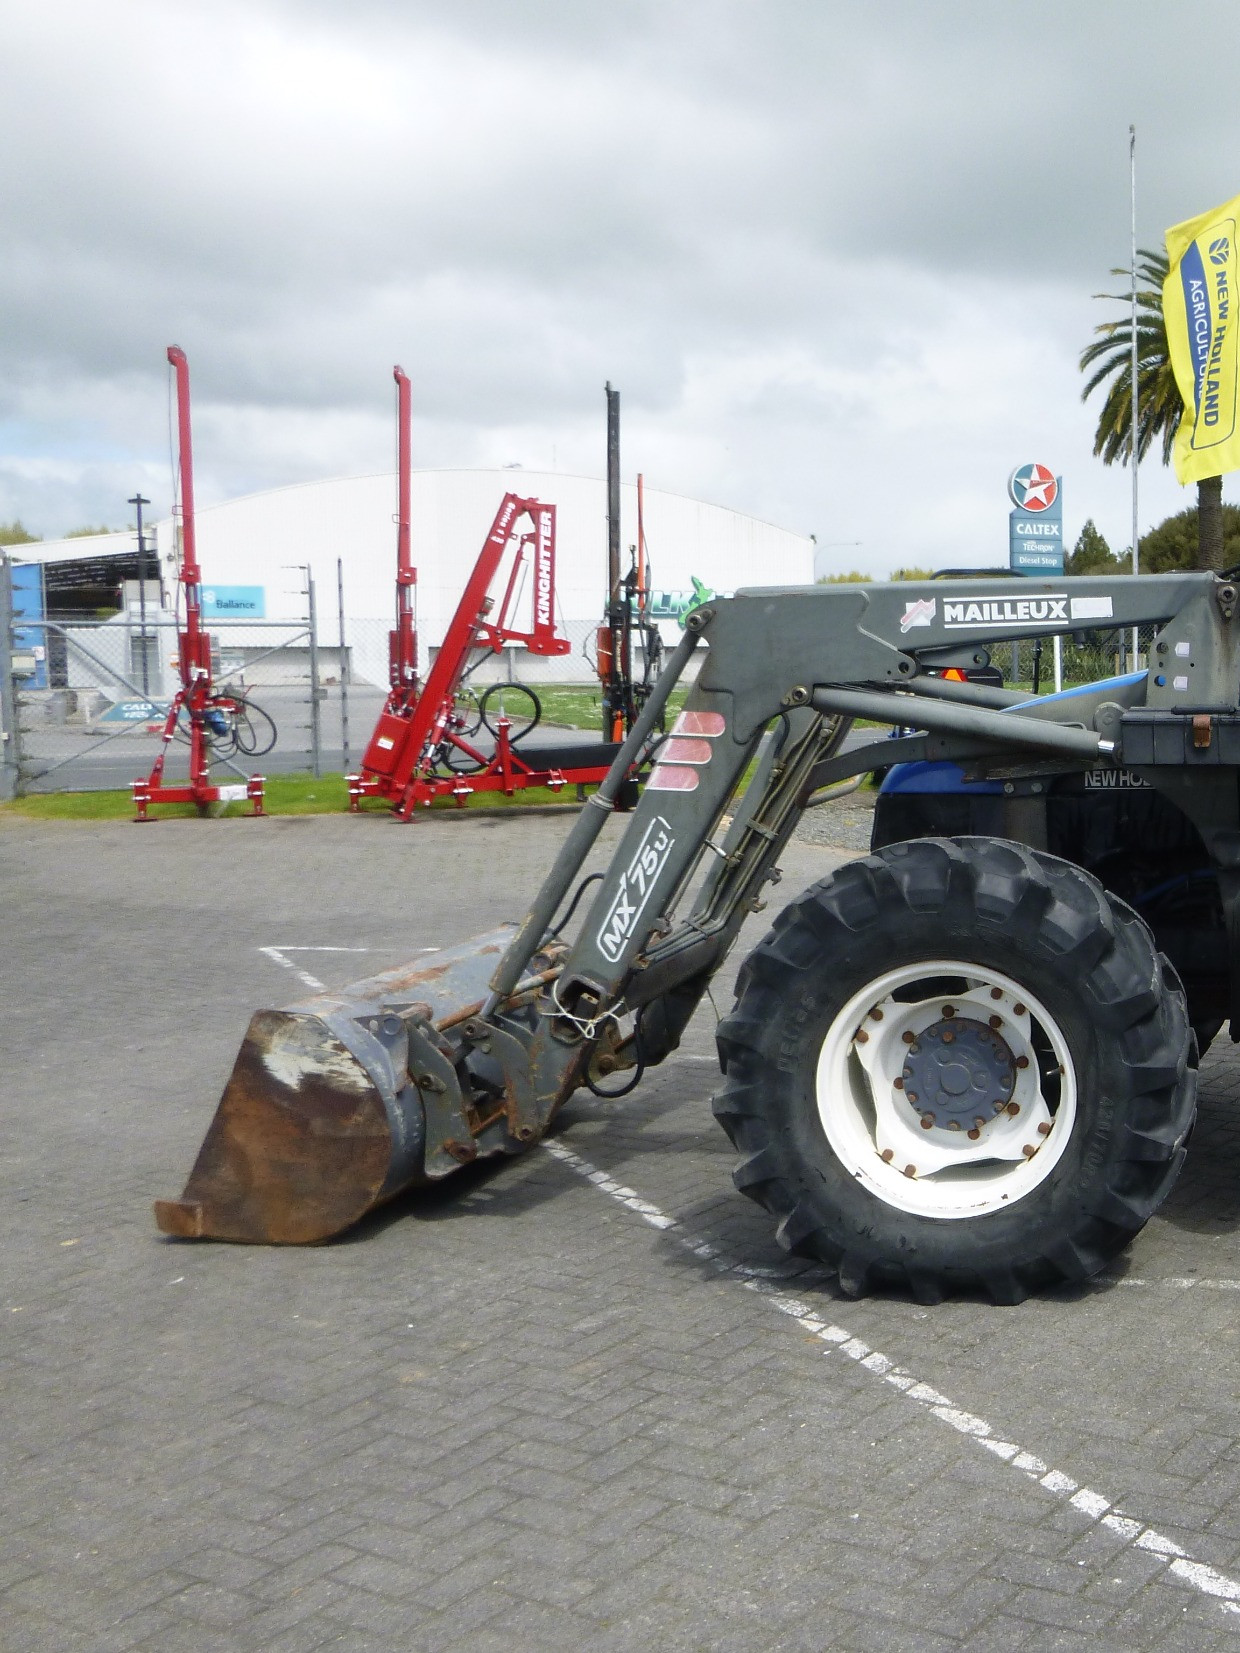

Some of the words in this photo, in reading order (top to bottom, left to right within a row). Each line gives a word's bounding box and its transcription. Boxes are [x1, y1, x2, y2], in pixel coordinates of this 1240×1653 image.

[1216, 271, 1229, 320] NEW
[1204, 325, 1227, 427] HOLLAND
[1016, 523, 1060, 536] CALTEX
[537, 511, 552, 625] KINGHITTER
[1019, 556, 1040, 565] Diesel
[1041, 557, 1057, 567] Stop
[216, 600, 255, 609] Ballance
[944, 600, 1068, 622] MAILLEUX
[1085, 770, 1117, 787] NEW
[603, 889, 637, 954] MX
